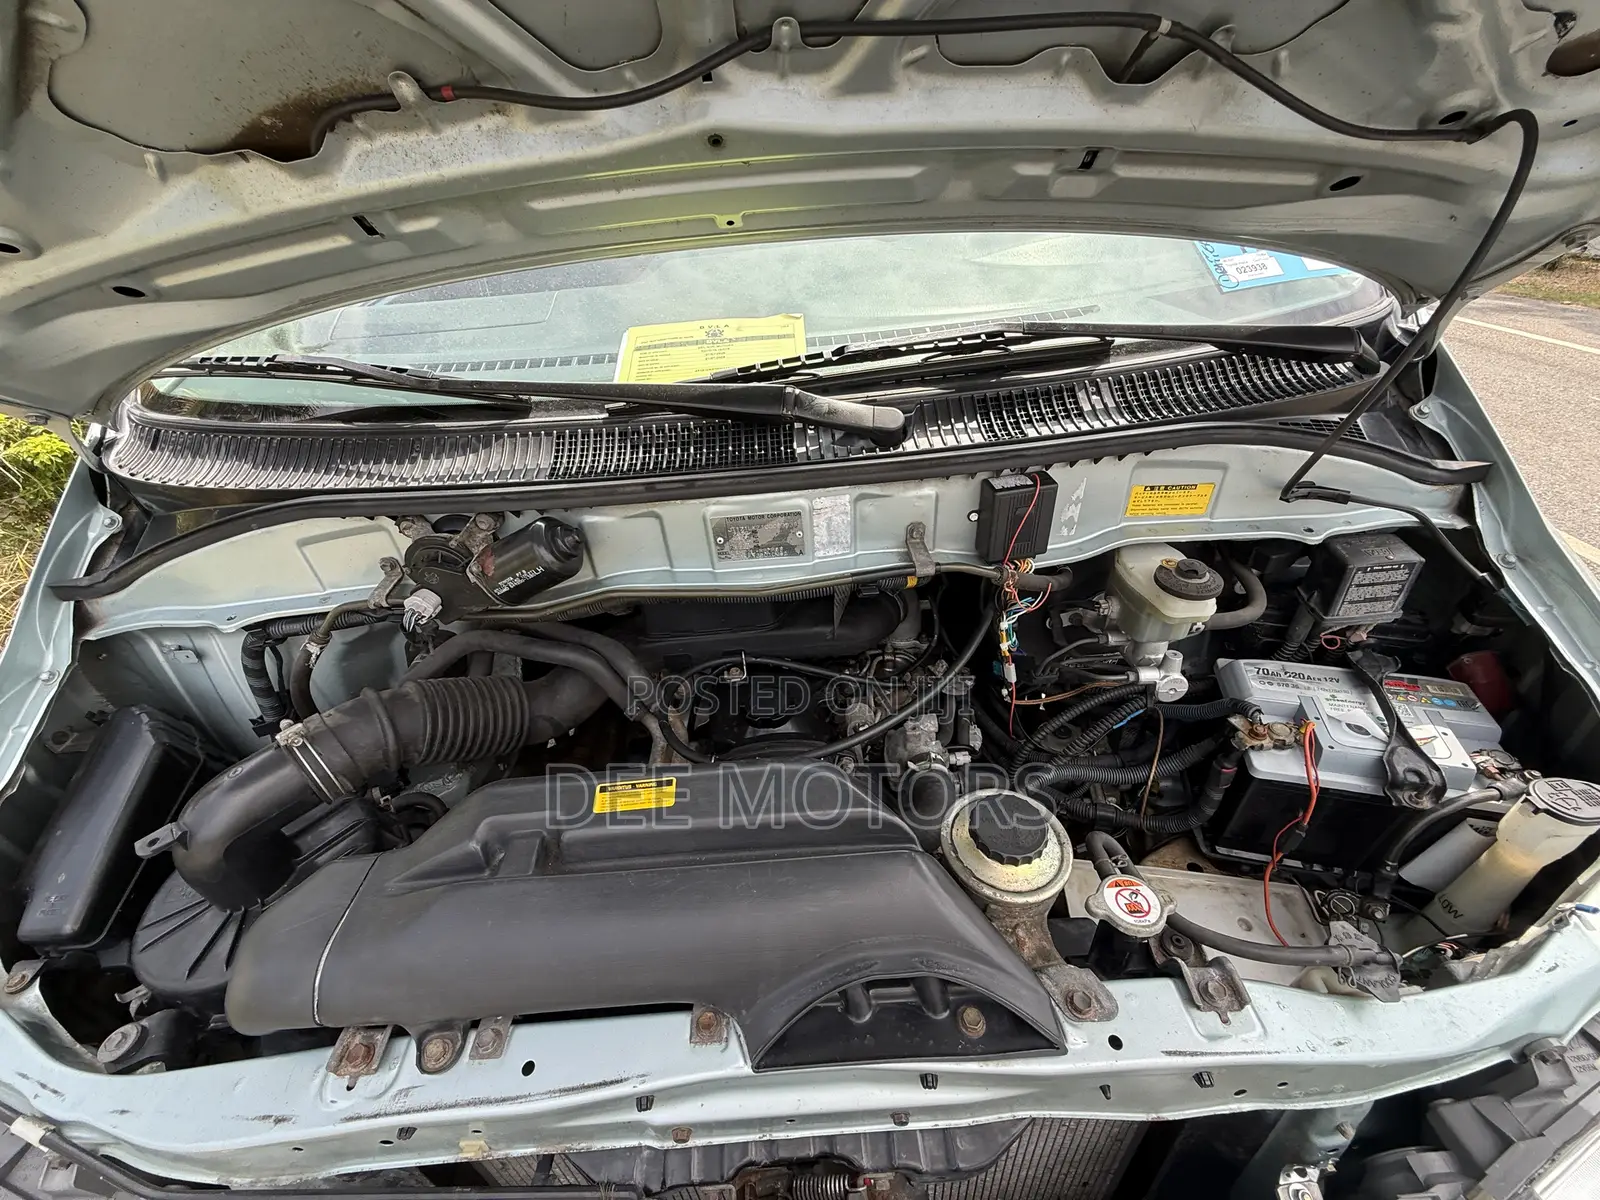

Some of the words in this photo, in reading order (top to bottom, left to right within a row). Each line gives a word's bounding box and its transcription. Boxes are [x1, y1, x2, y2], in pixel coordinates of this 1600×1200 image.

[1235, 262, 1268, 274] 023938
[766, 511, 801, 519] CORPORATION
[1437, 893, 1464, 920] LOW
